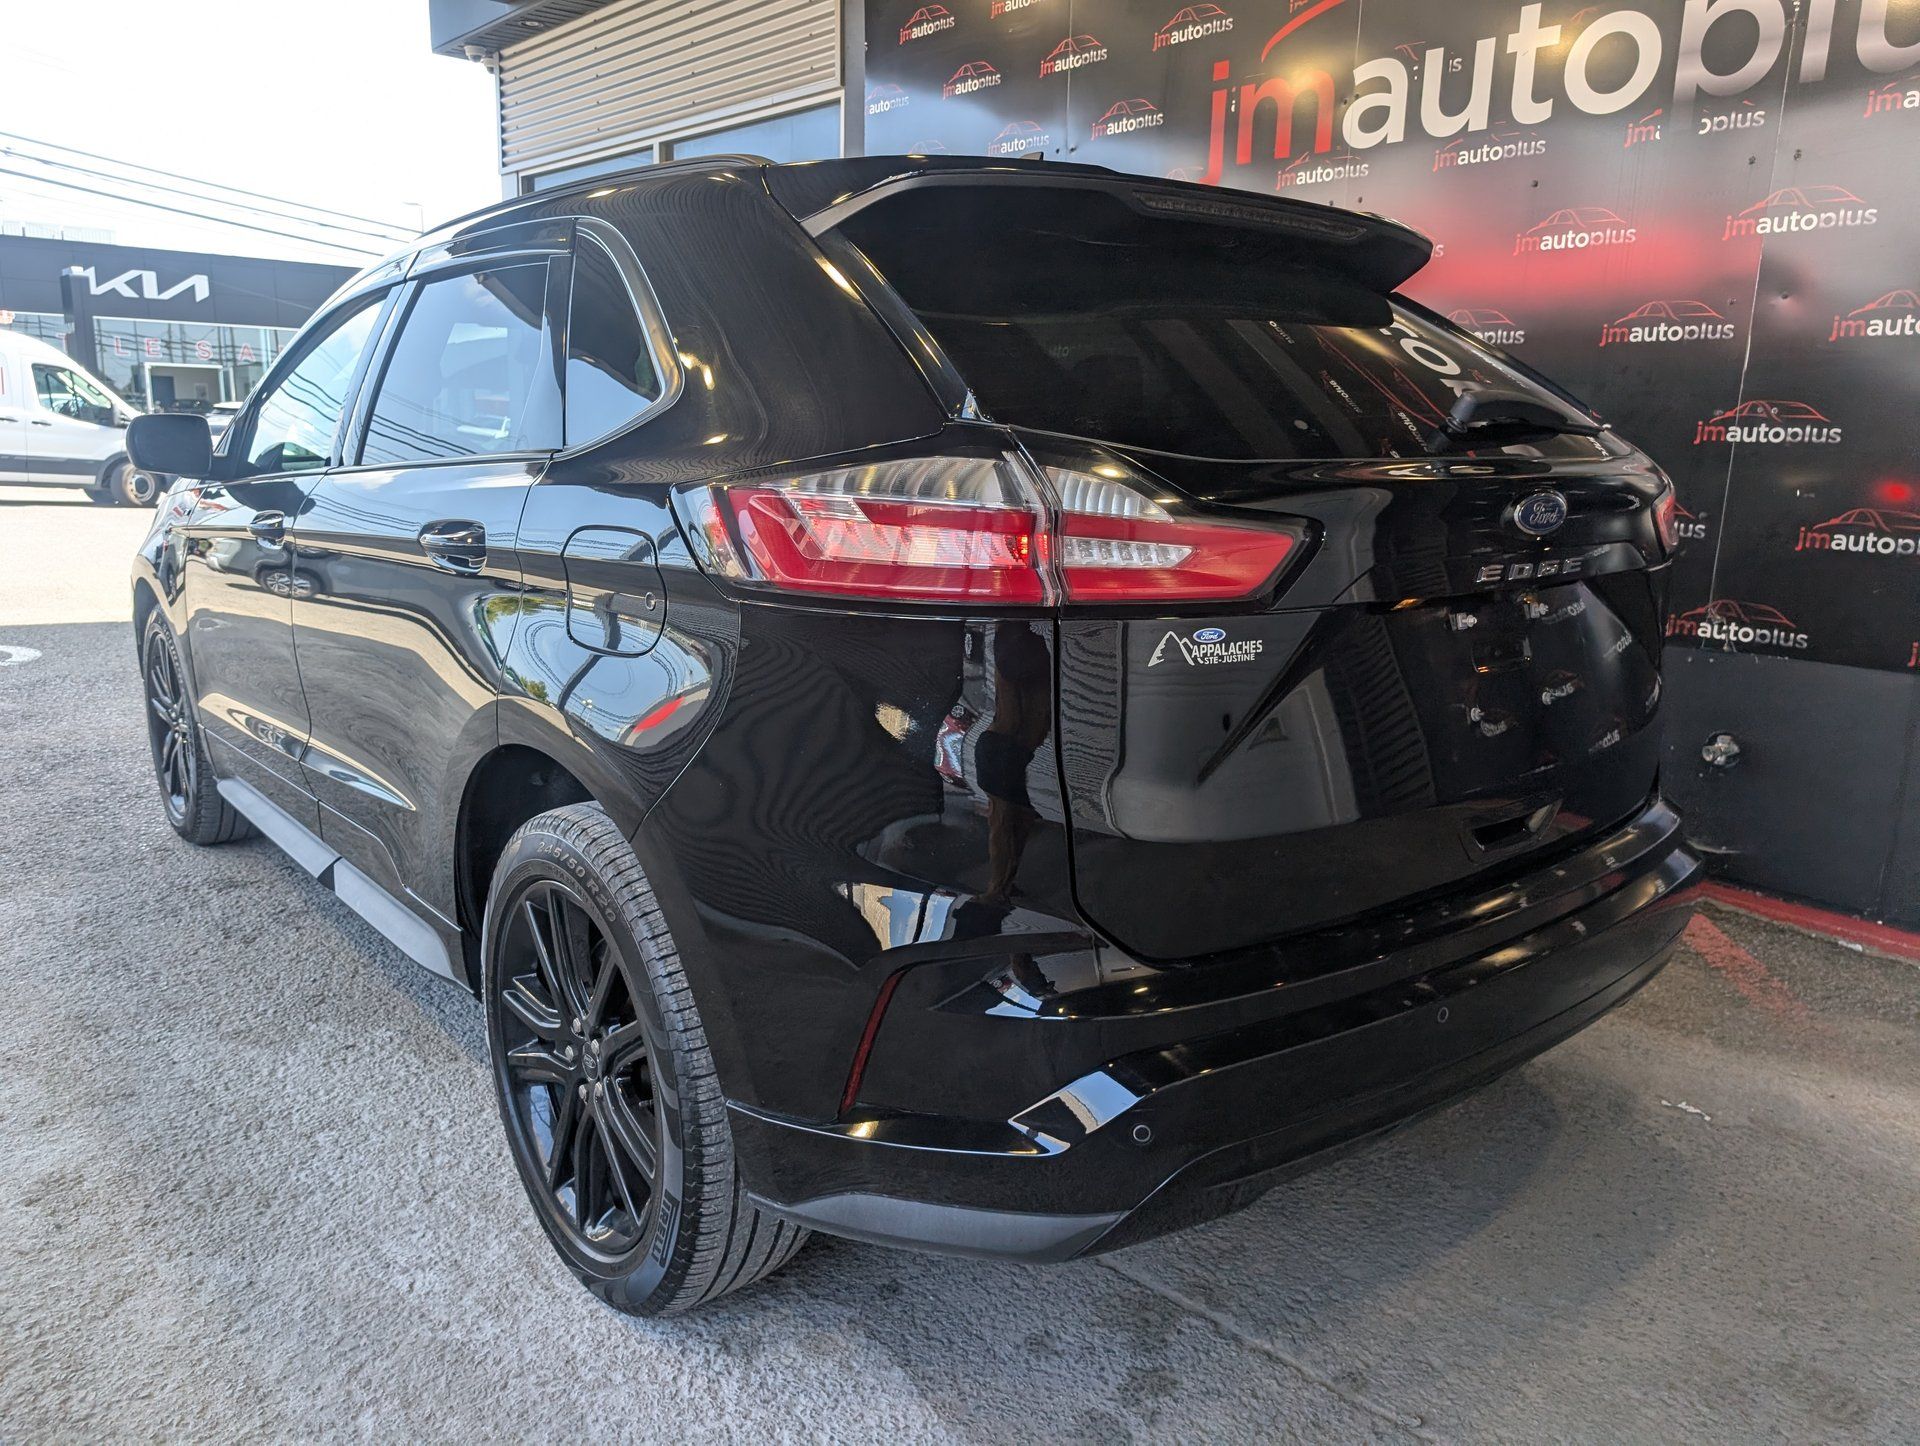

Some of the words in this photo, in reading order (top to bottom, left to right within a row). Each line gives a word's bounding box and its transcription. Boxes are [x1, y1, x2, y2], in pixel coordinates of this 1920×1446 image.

[900, 16, 955, 45] jmautoplus
[1152, 17, 1233, 52] jmautoplus
[1040, 48, 1107, 78] jmautoplus
[943, 73, 1001, 100] jmautoplus
[1091, 113, 1164, 141] jmautoplus
[988, 134, 1050, 157] jmautoplus
[1432, 139, 1546, 172] jmautoplus
[1276, 163, 1369, 191] jmautoplus
[1722, 207, 1878, 241] jmautoplus
[1513, 227, 1636, 256] jmautoplus
[84, 266, 210, 302] KIA
[1599, 322, 1735, 347] jmautoplus
[1693, 421, 1842, 445] jmautoplus
[1476, 557, 1585, 583] EDGE
[1665, 614, 1809, 649] jmautoplus
[1191, 640, 1263, 658] APPALACHES
[1204, 653, 1256, 665] STE-JUSTINE
